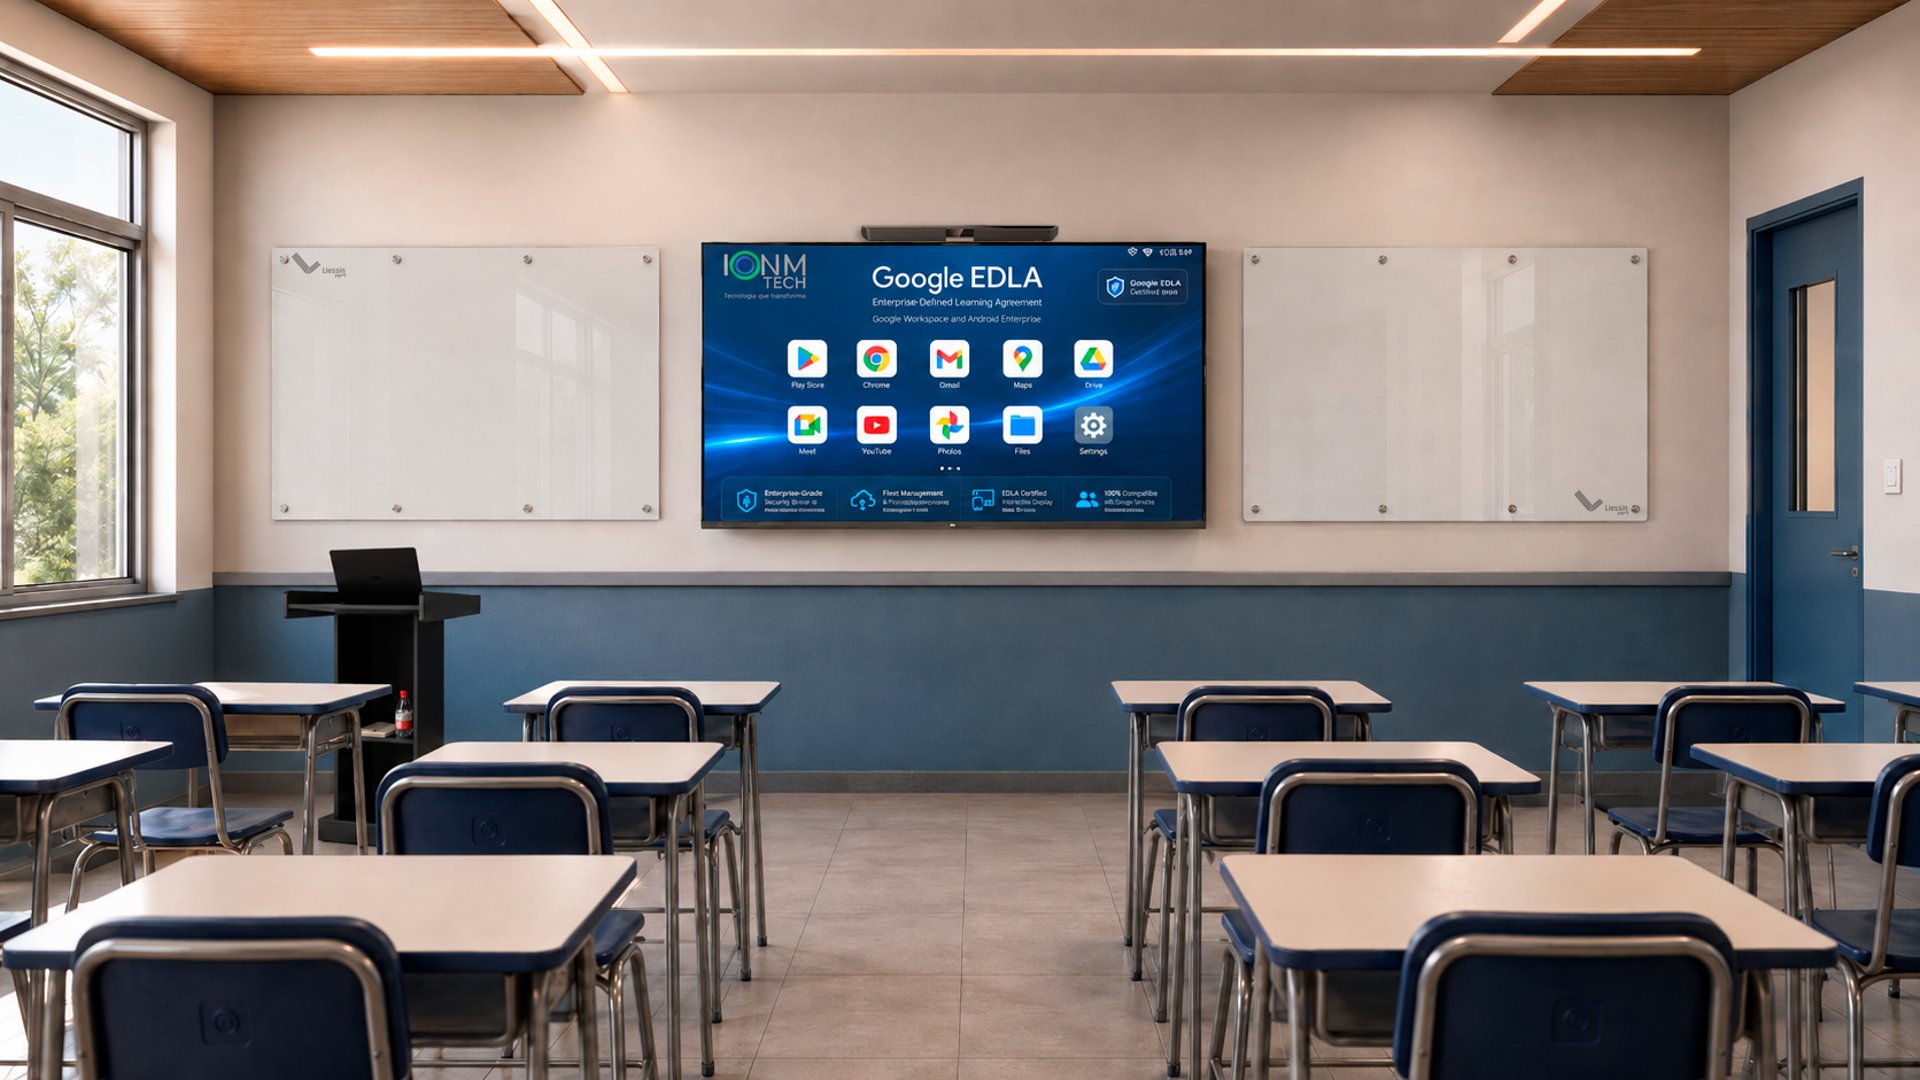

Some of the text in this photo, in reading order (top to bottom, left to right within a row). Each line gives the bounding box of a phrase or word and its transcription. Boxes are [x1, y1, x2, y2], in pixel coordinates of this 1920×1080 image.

[763, 276, 806, 289] TECH
[872, 265, 1043, 295] Google EDLA
[1130, 280, 1158, 288] Google
[955, 298, 993, 308] Learning
[995, 298, 1043, 308] Agreement
[872, 315, 1041, 325] Google Workspace and Android Enterprise
[791, 382, 806, 390] Play
[1014, 382, 1033, 390] Maps
[1079, 448, 1108, 456] Settings
[901, 490, 944, 498] Management
